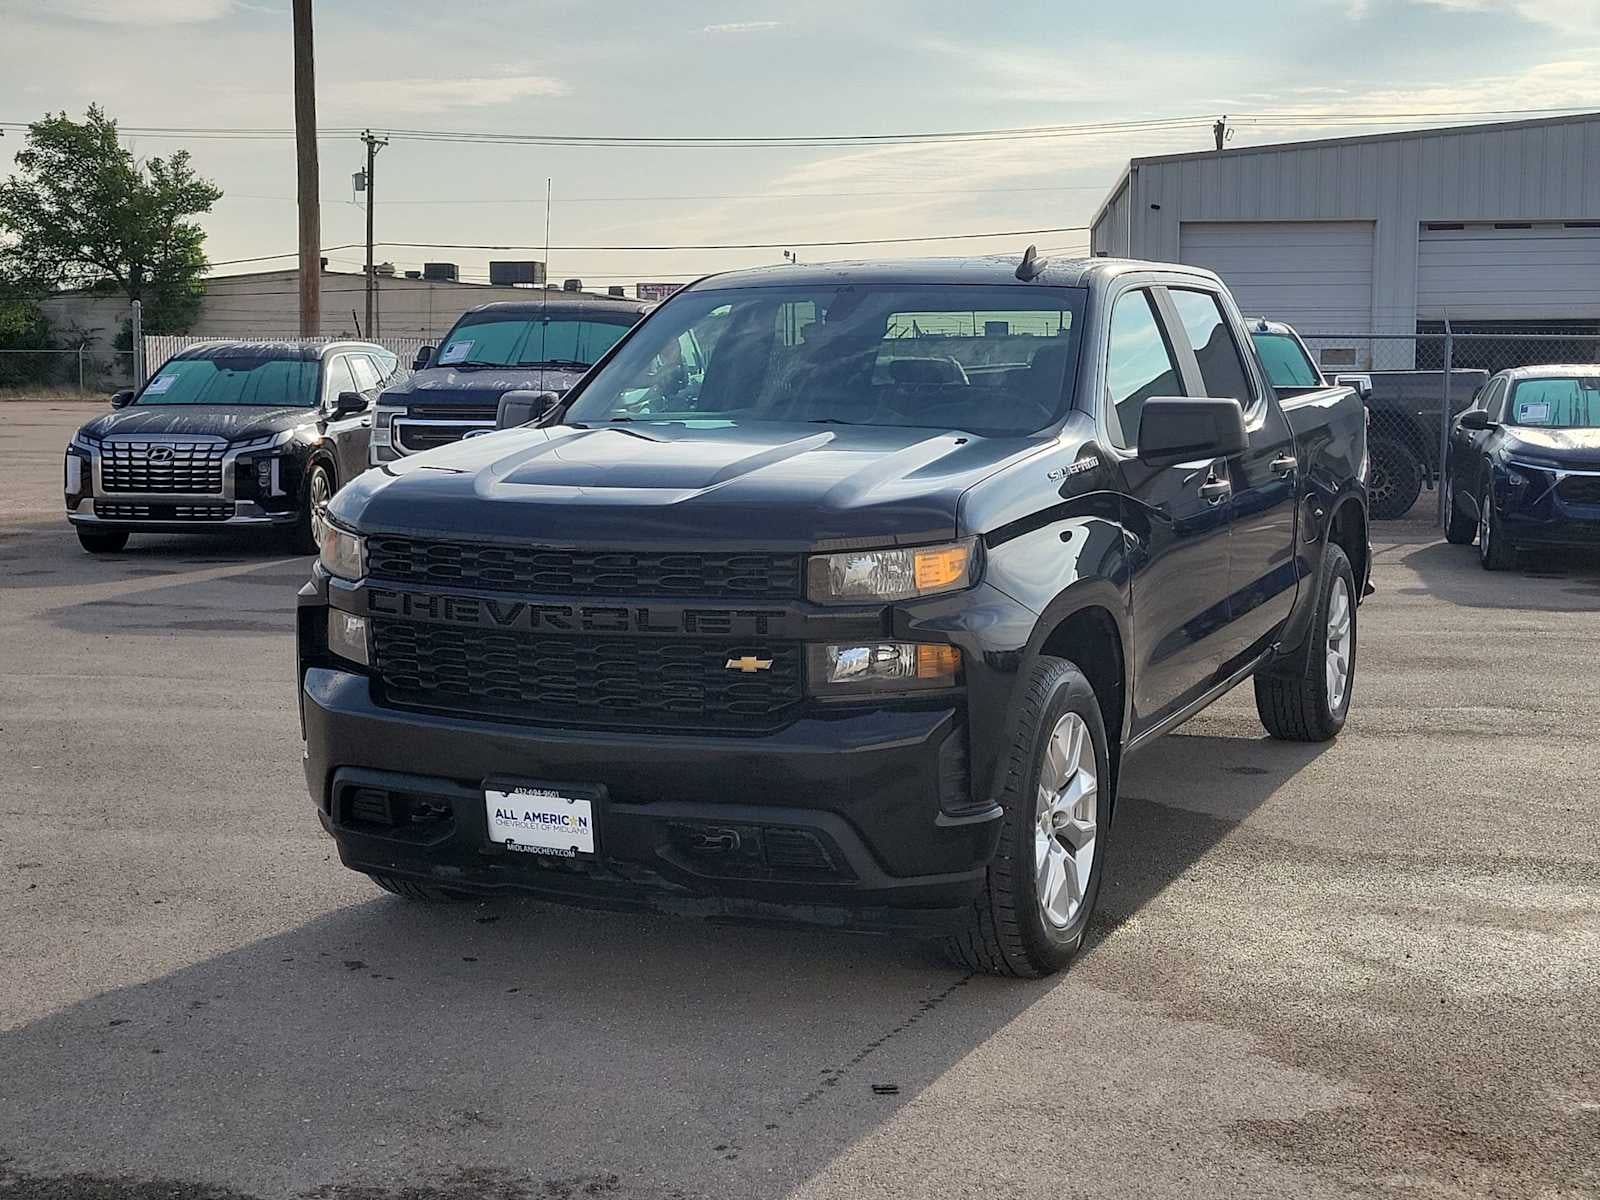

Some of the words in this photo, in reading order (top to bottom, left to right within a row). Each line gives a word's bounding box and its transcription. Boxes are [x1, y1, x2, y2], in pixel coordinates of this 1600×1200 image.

[367, 589, 787, 636] CHEVROLET
[495, 808, 518, 821] ALL
[495, 819, 540, 831] CHEVROLET
[541, 824, 552, 832] OF
[553, 826, 589, 835] MIDLAND
[507, 844, 576, 858] MIDLANDCHEVY.COM
